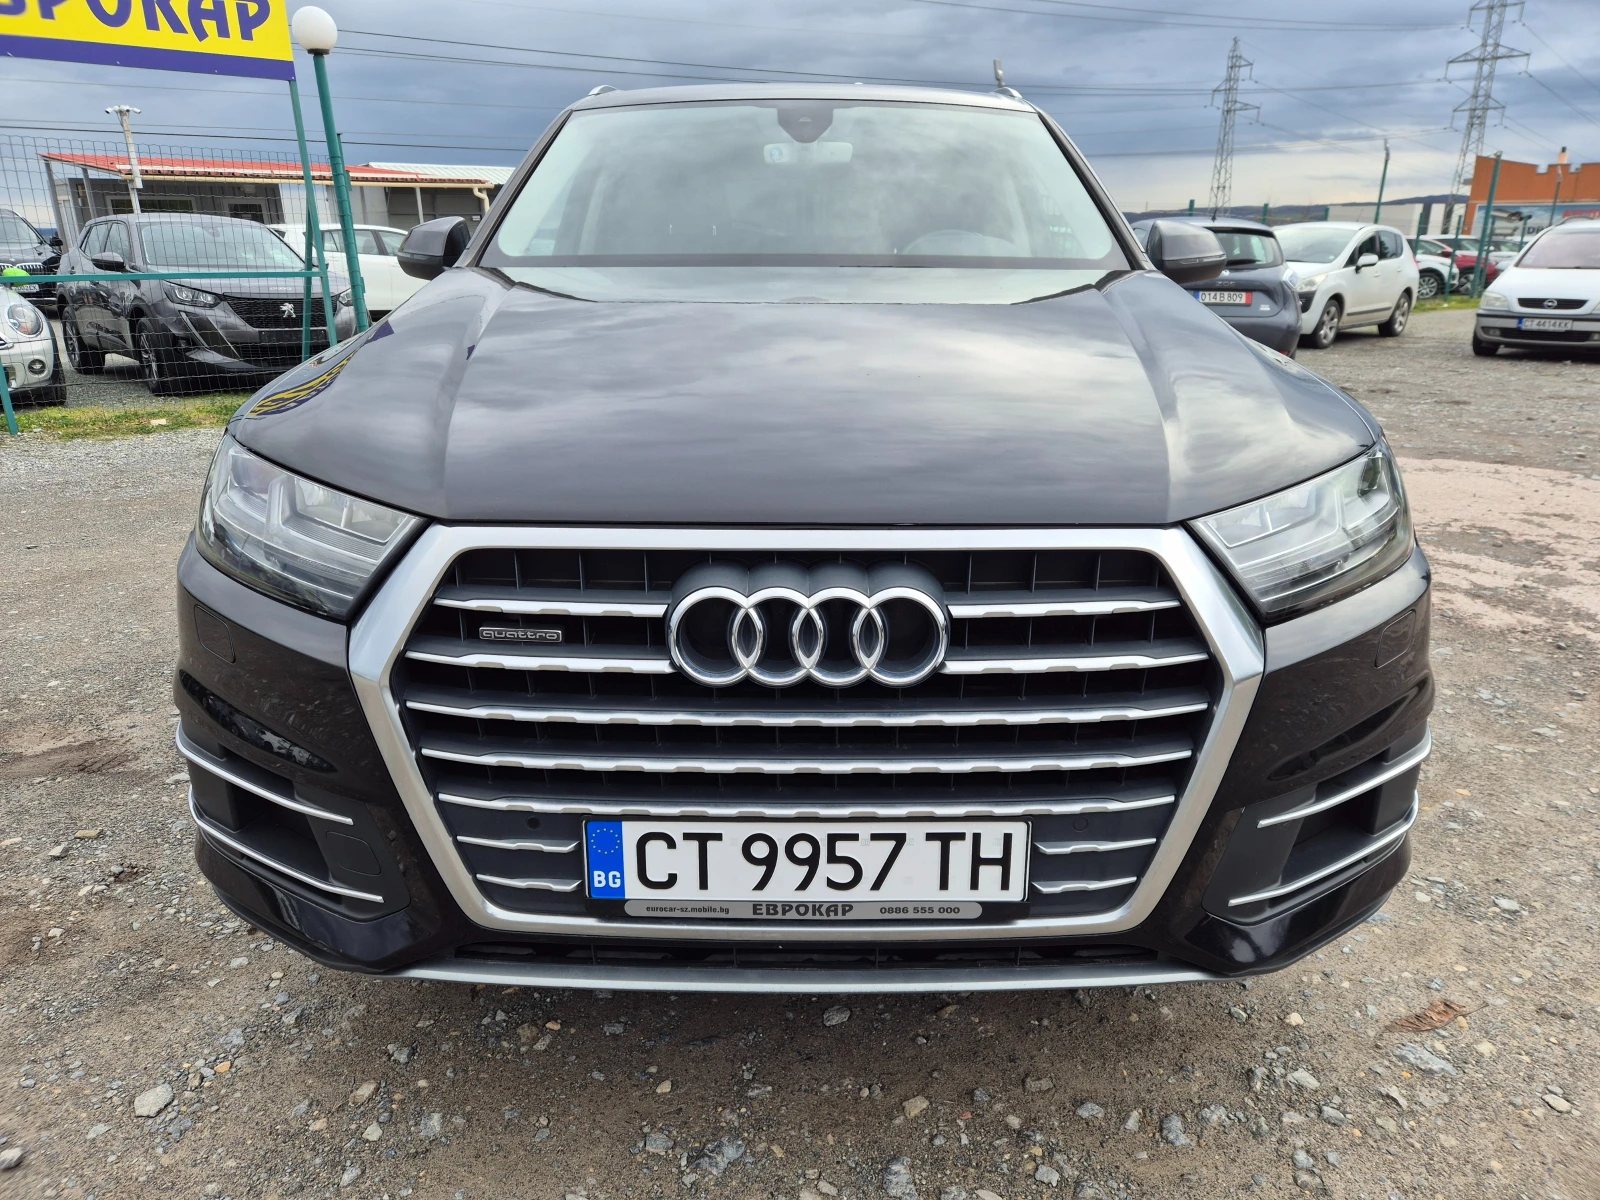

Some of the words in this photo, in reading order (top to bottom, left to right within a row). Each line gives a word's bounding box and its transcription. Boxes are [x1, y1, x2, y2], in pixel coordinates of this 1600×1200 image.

[482, 630, 558, 639] quattro
[636, 831, 723, 891] CT
[741, 832, 907, 891] 9957
[925, 832, 1013, 891] TH
[593, 870, 621, 888] BG
[645, 905, 730, 915] eurocar-sz.mobile.bg
[752, 903, 854, 918] ЕВРОКАР
[879, 906, 909, 914] 0886
[912, 906, 934, 914] 555
[938, 906, 960, 914] 000
